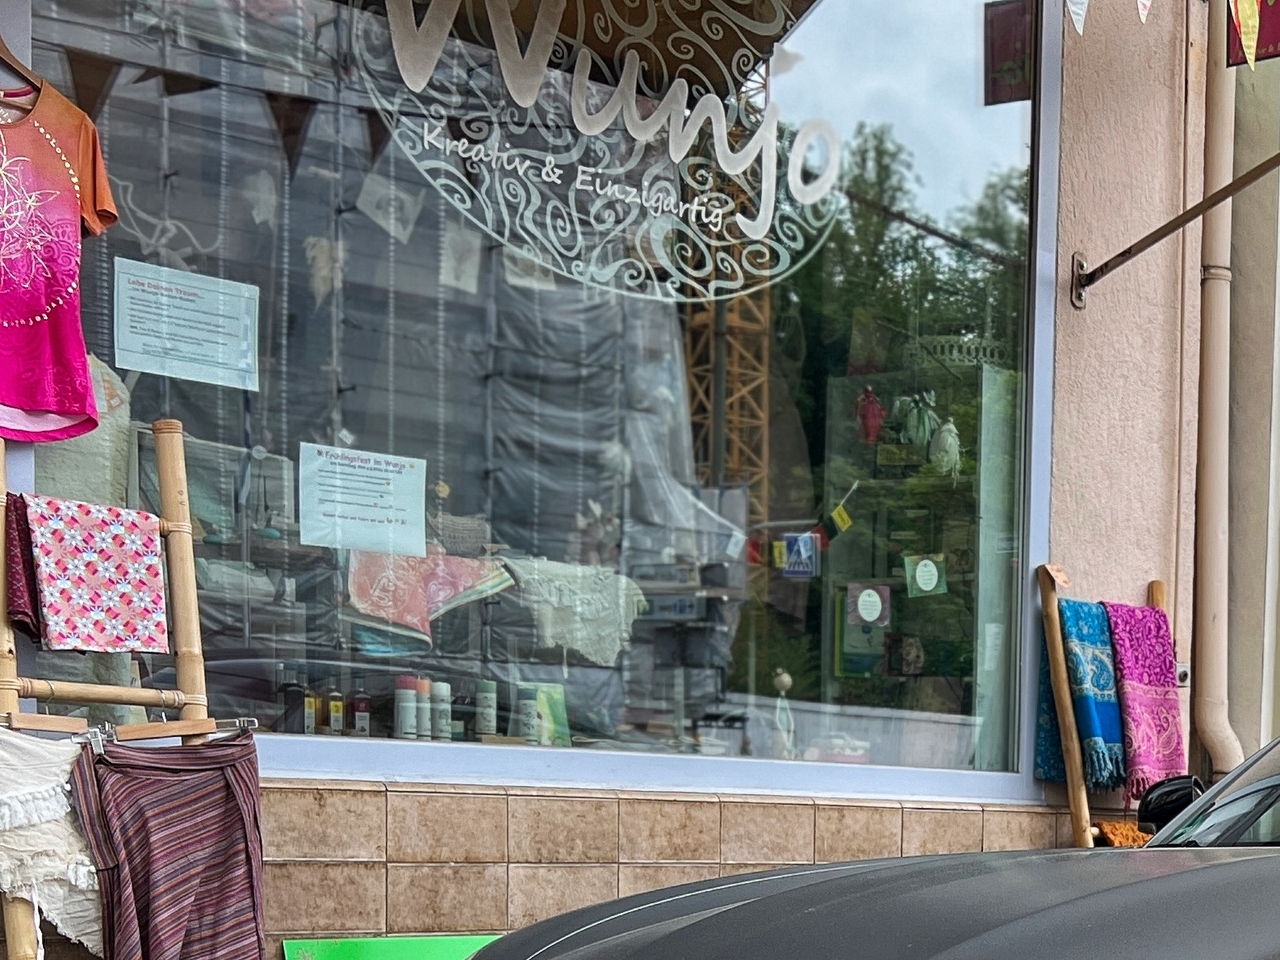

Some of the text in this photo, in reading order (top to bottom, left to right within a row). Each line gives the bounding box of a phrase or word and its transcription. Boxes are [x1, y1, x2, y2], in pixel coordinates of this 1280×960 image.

[387, 0, 839, 240] Wunjo
[421, 121, 725, 232] Kreativ & Einzigartig
